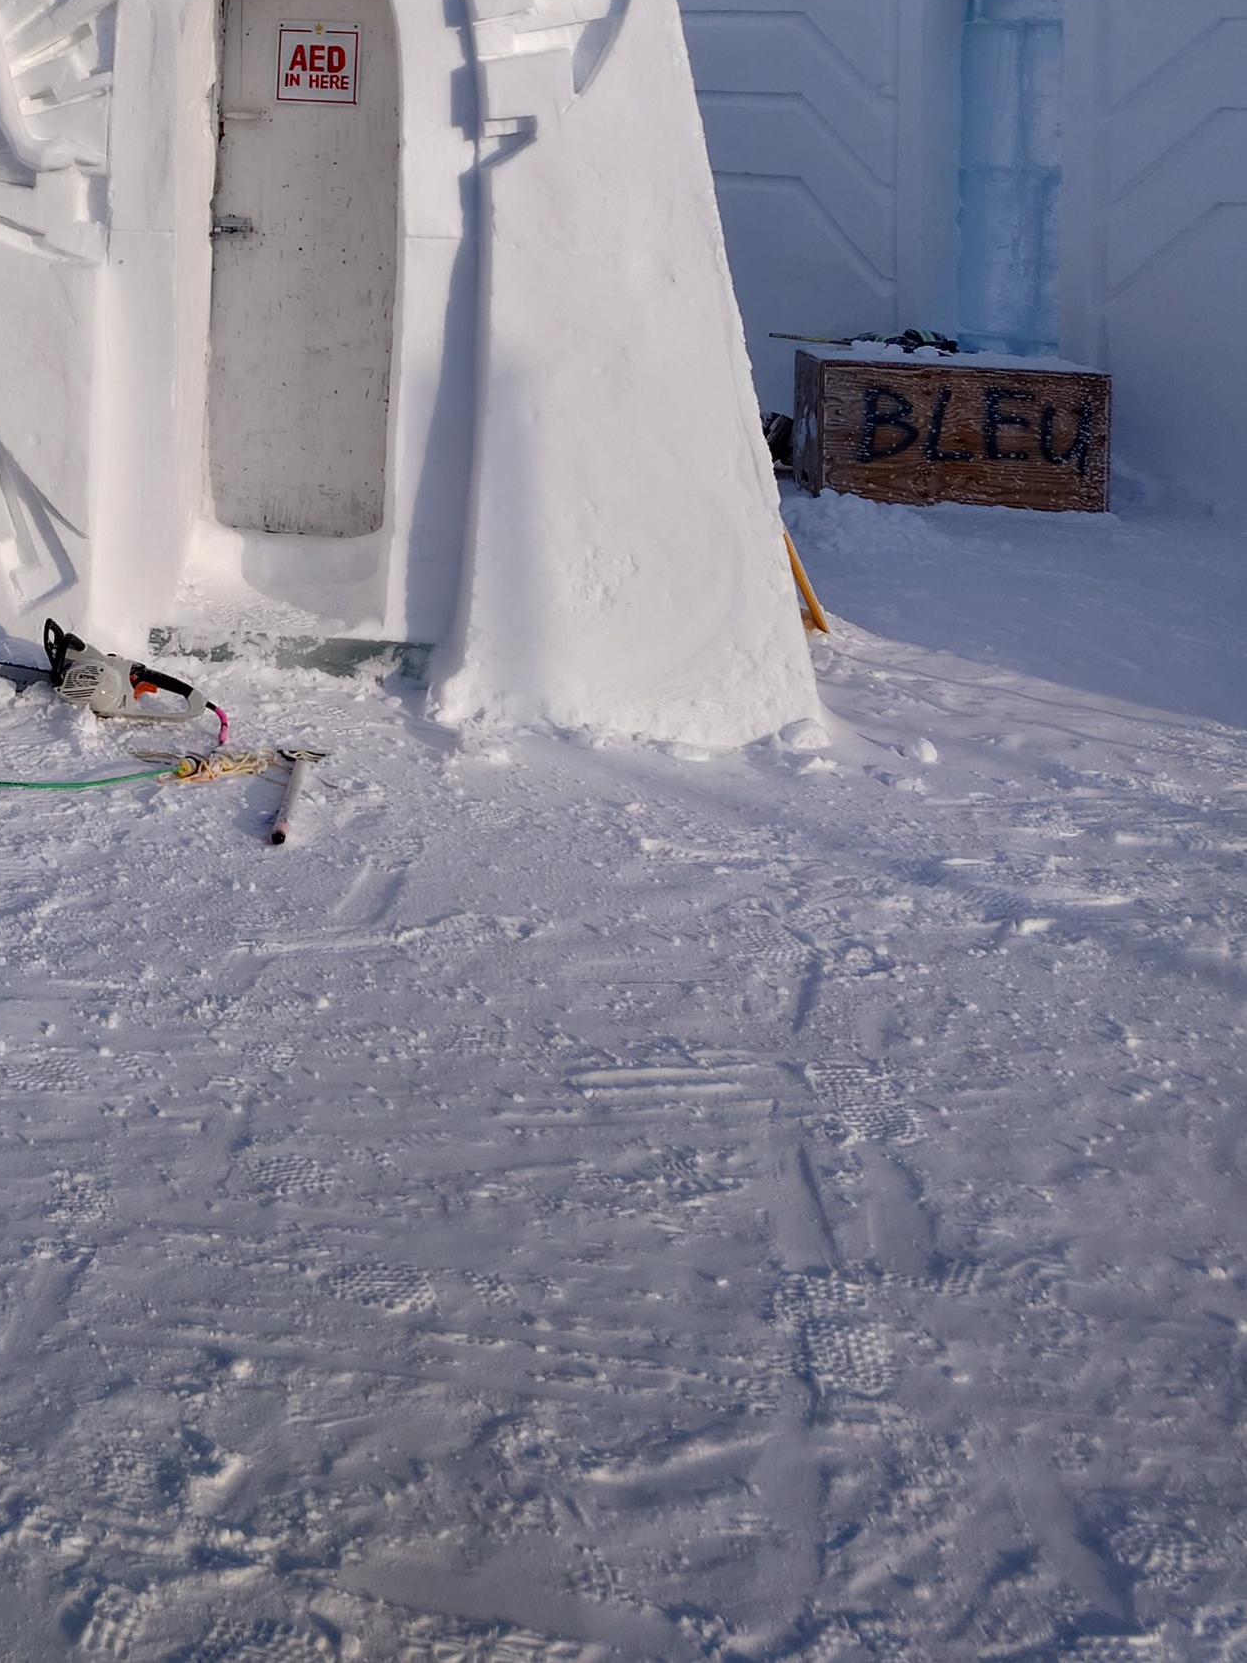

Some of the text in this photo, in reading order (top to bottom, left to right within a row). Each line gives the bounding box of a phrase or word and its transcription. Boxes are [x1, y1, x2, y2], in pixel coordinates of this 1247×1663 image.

[289, 44, 346, 73] AED
[284, 73, 350, 90] IN HERE
[856, 386, 1093, 476] BLEU
